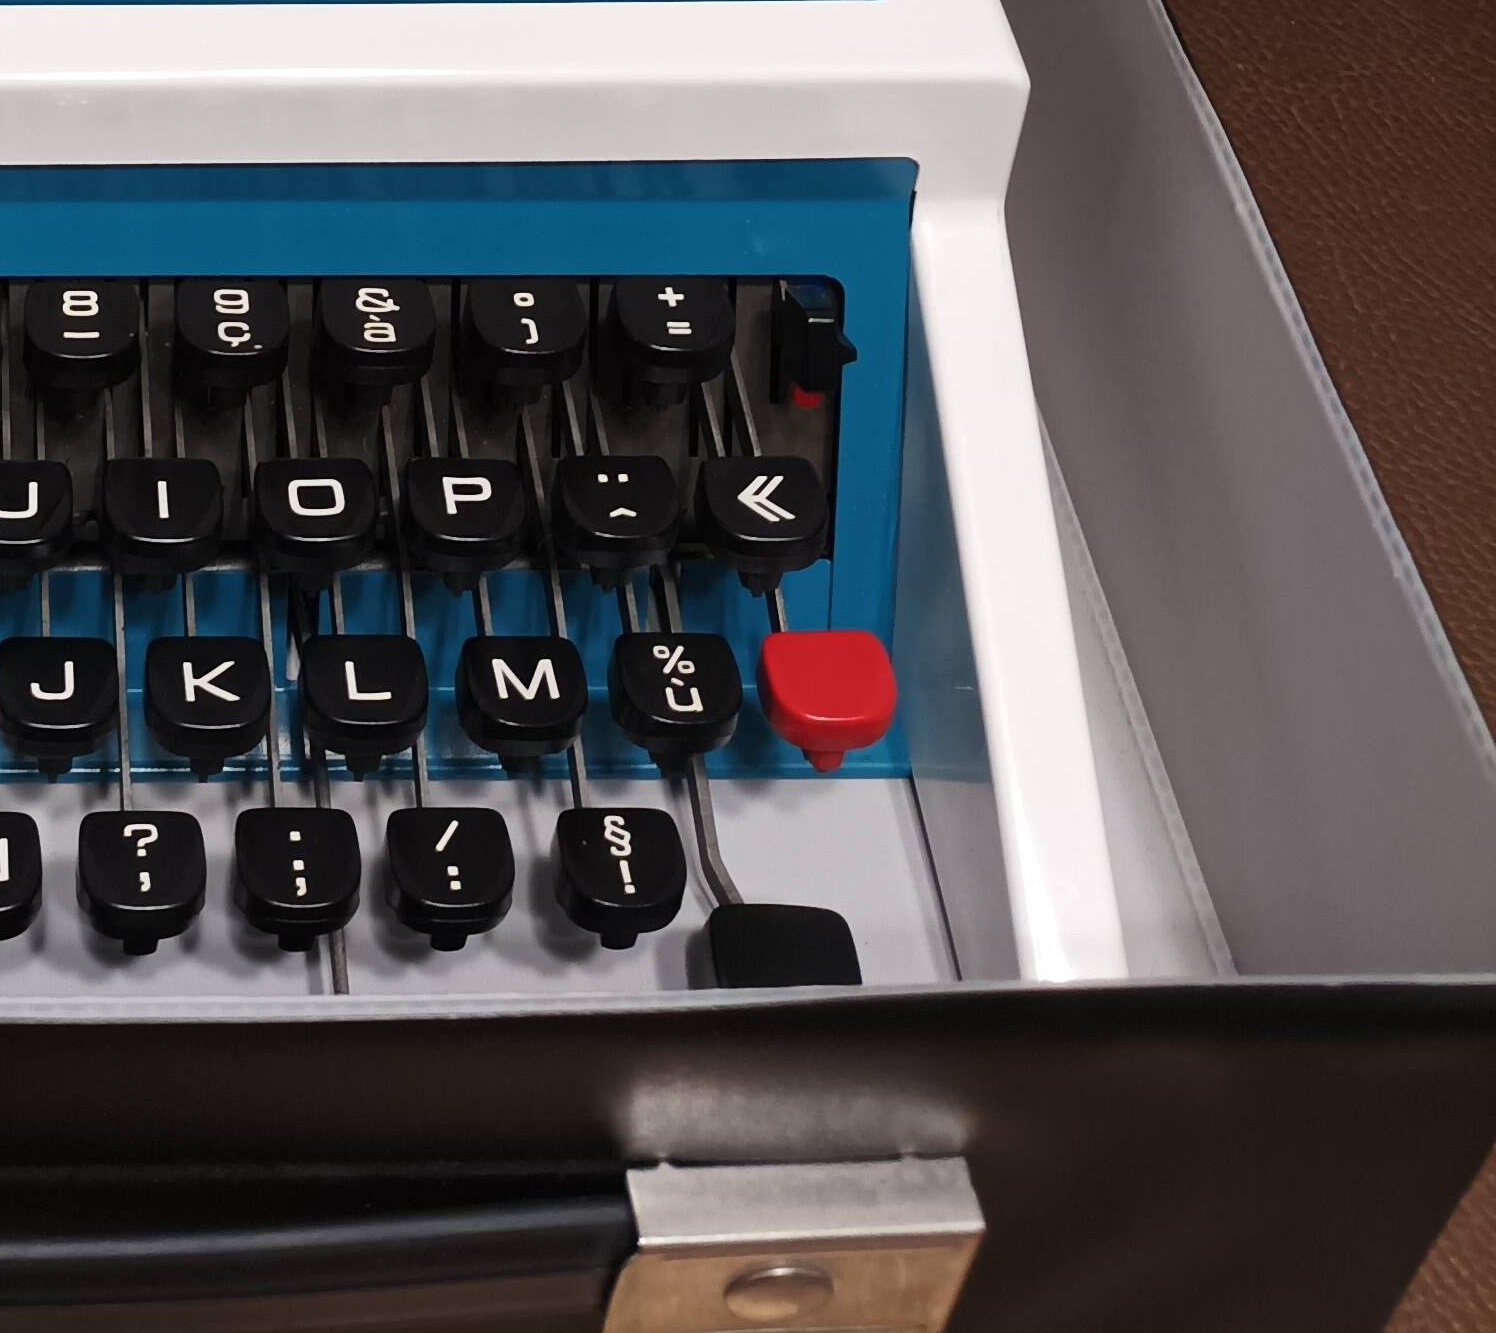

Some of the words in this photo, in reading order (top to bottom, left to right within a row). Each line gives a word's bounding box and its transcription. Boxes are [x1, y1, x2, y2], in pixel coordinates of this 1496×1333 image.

[62, 290, 99, 317] 8
[213, 288, 250, 315] 9
[355, 287, 401, 313] &
[657, 286, 685, 307] +
[217, 321, 251, 348] ç
[363, 314, 397, 343] à
[666, 321, 692, 335] =
[157, 480, 170, 519] I
[287, 478, 346, 517] O
[442, 476, 492, 515] P
[30, 660, 75, 701] J
[182, 660, 241, 702] K
[344, 660, 392, 701] L
[491, 658, 561, 700] M
[652, 645, 695, 674] %
[665, 677, 704, 712] ù
[123, 823, 159, 857] ?
[435, 820, 459, 852] /
[603, 815, 632, 857] §
[447, 865, 462, 891] :
[619, 859, 636, 894] !
